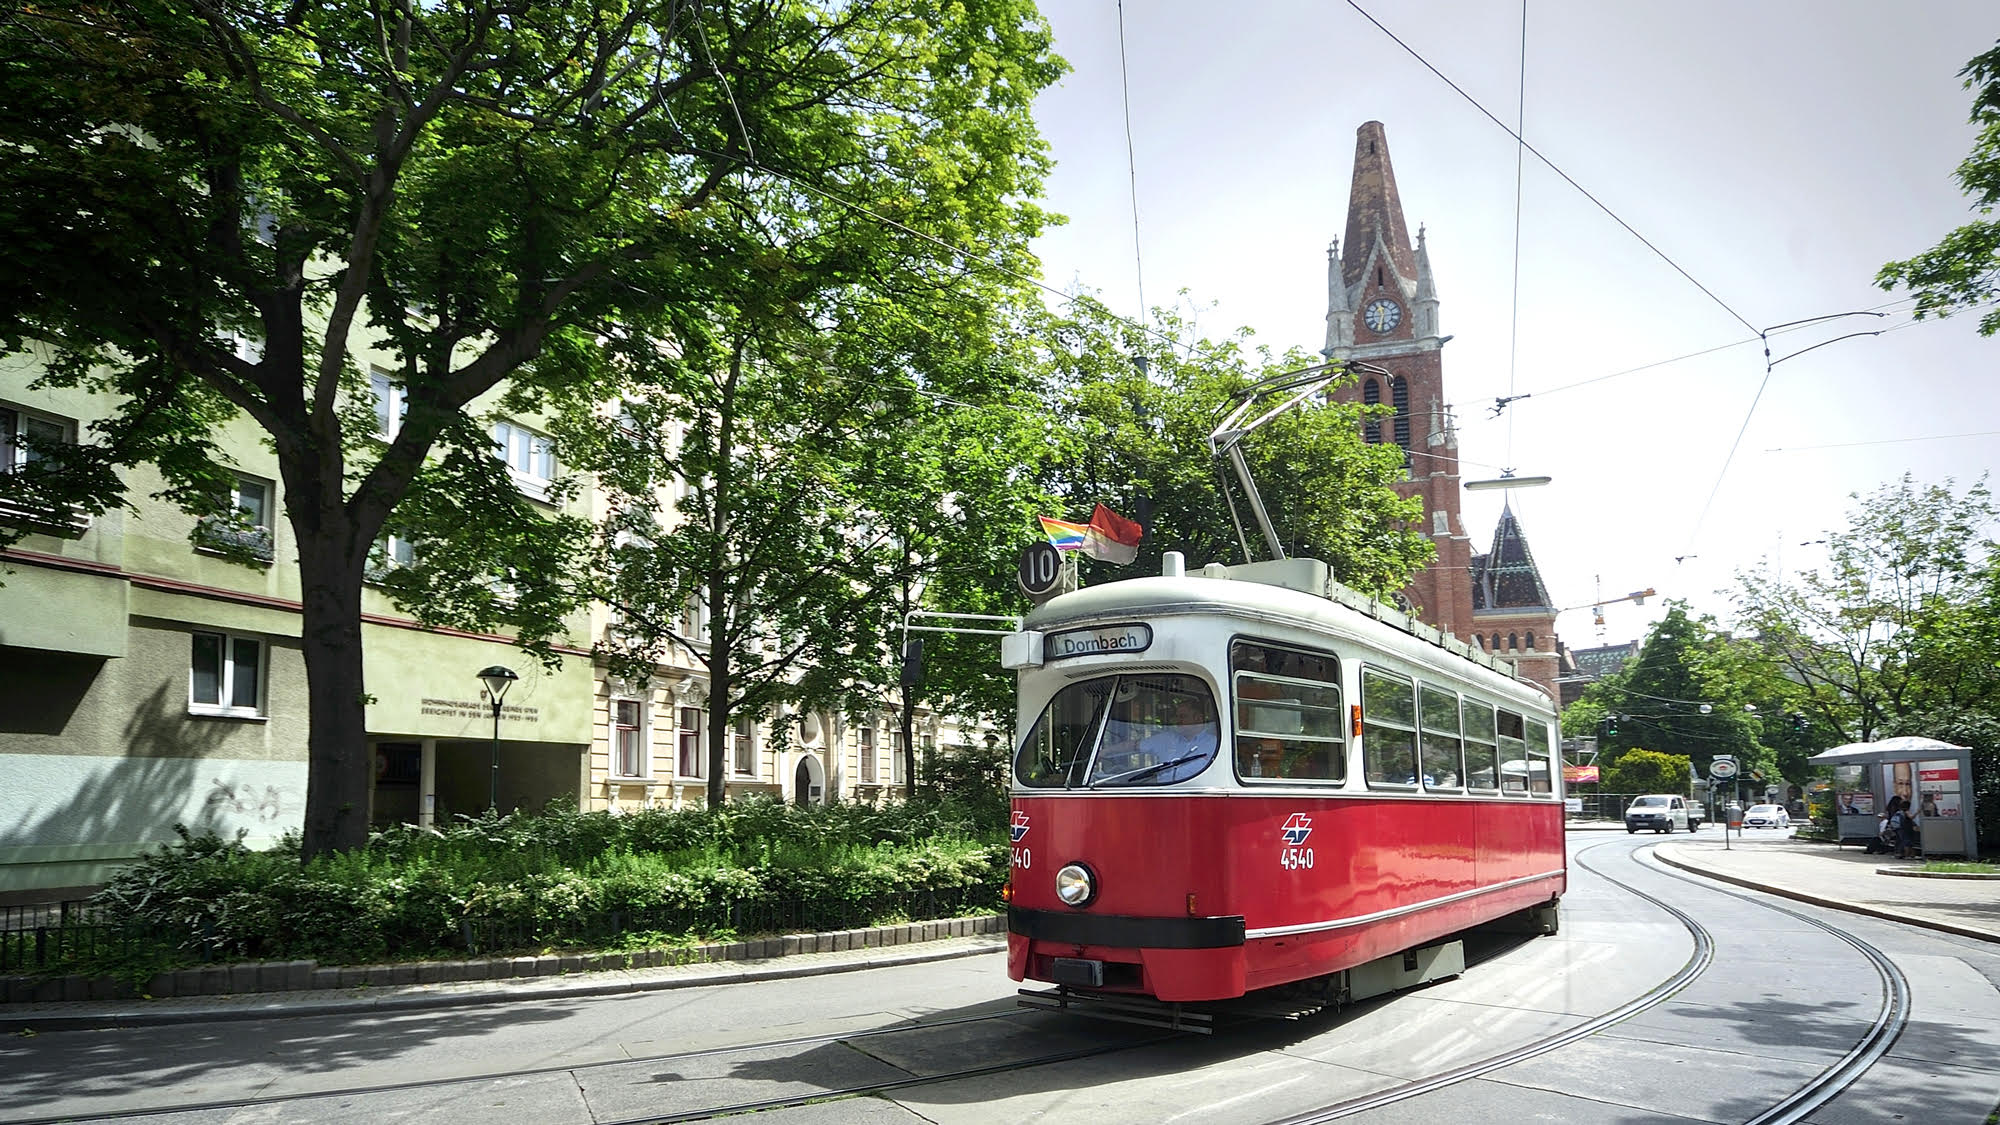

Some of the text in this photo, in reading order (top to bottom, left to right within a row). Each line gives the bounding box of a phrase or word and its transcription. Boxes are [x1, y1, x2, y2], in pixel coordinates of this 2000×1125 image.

[1029, 549, 1054, 585] 10
[1064, 632, 1137, 653] Dornbach
[1280, 848, 1314, 870] 4540
